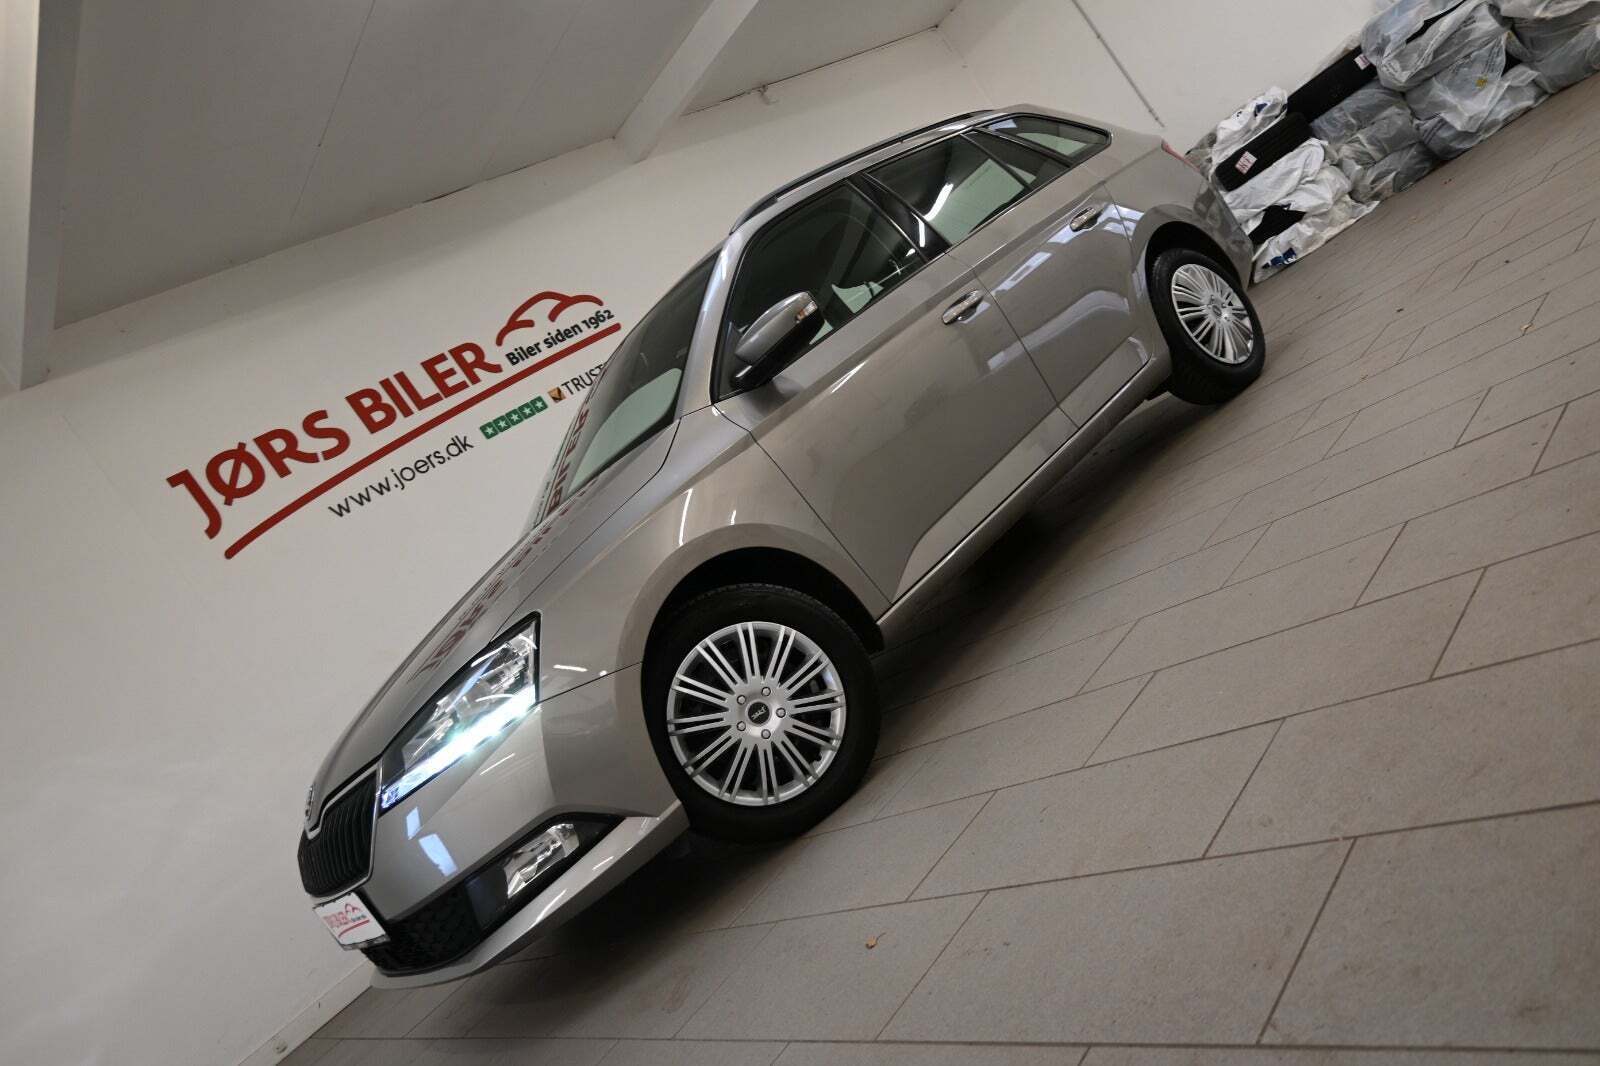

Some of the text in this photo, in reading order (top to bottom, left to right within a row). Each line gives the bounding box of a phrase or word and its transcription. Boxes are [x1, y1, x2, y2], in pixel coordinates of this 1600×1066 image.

[505, 309, 615, 366] Biler siden 1962
[166, 342, 503, 540] JØRS BILER
[328, 433, 474, 518] www.joers.dk
